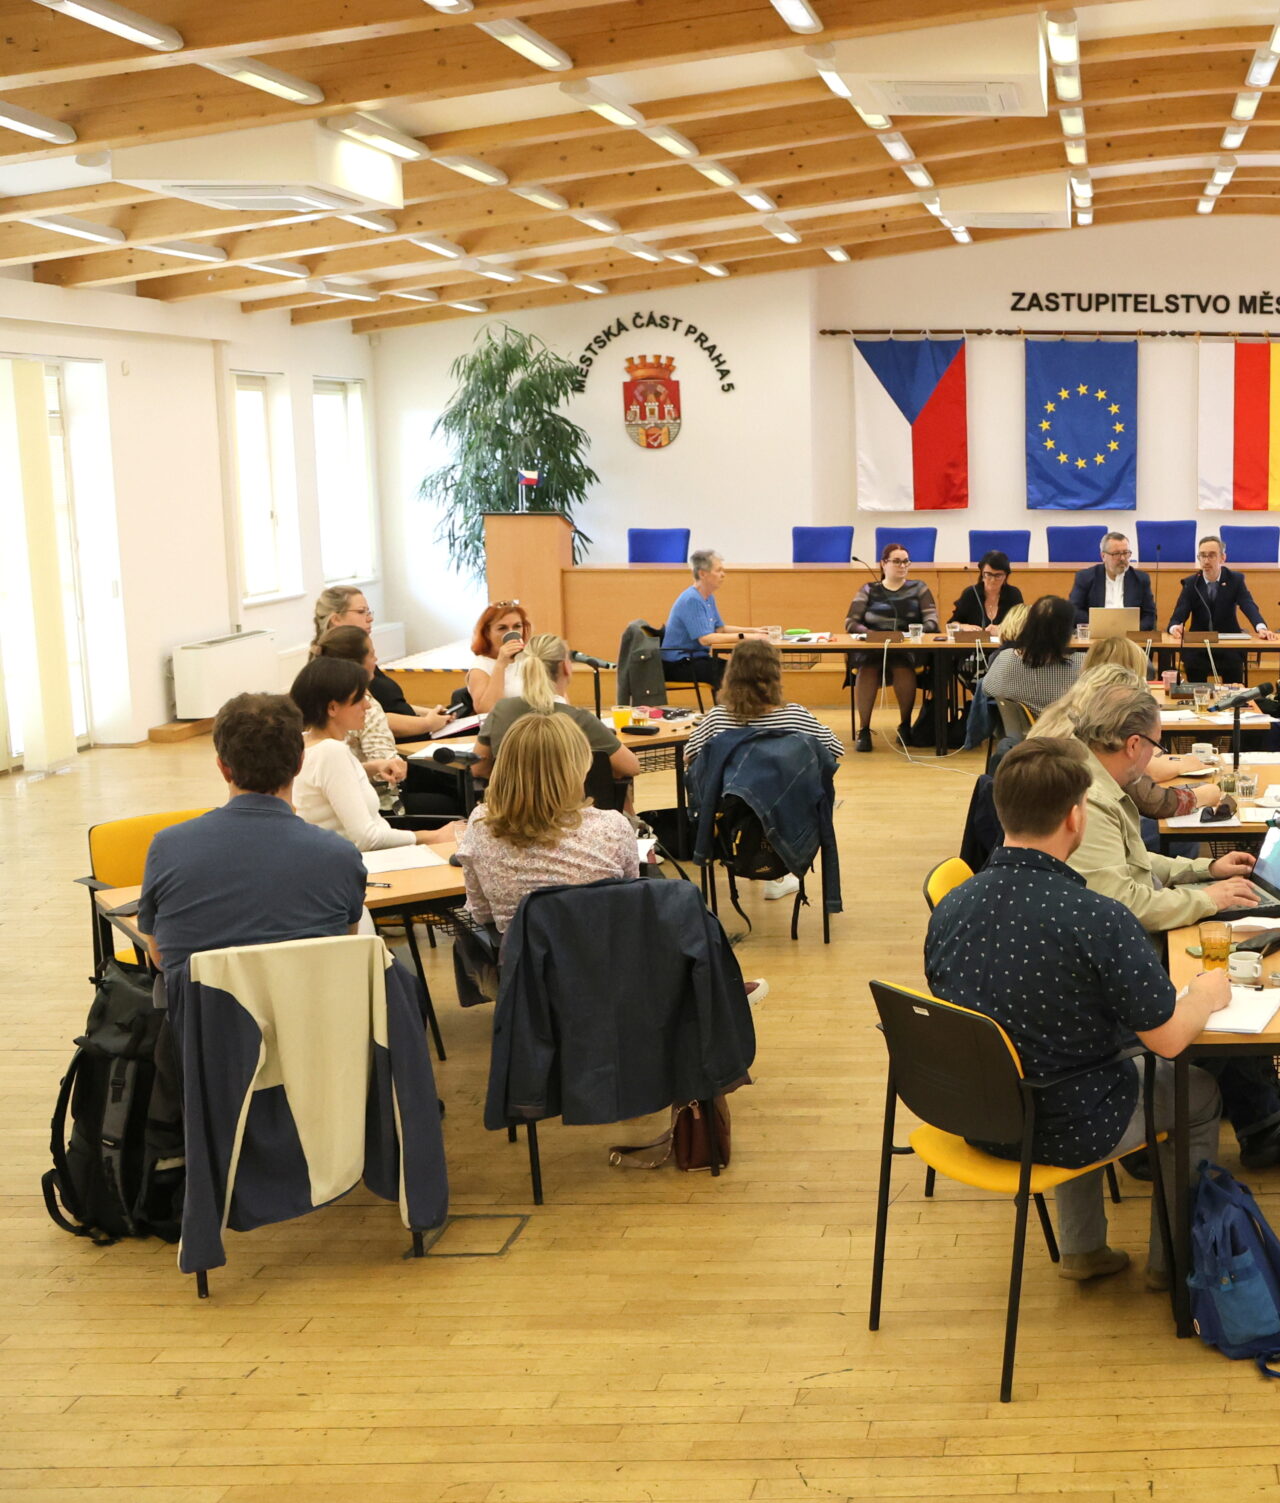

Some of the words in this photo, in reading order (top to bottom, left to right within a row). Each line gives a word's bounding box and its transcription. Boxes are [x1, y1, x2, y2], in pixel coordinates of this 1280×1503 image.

[1010, 291, 1230, 315] ZASTUPITELSTVO
[572, 318, 630, 394] MĚSTSKÁ
[632, 311, 683, 332] ČÁST
[684, 324, 731, 381] PRAHA
[721, 382, 735, 393] 5
